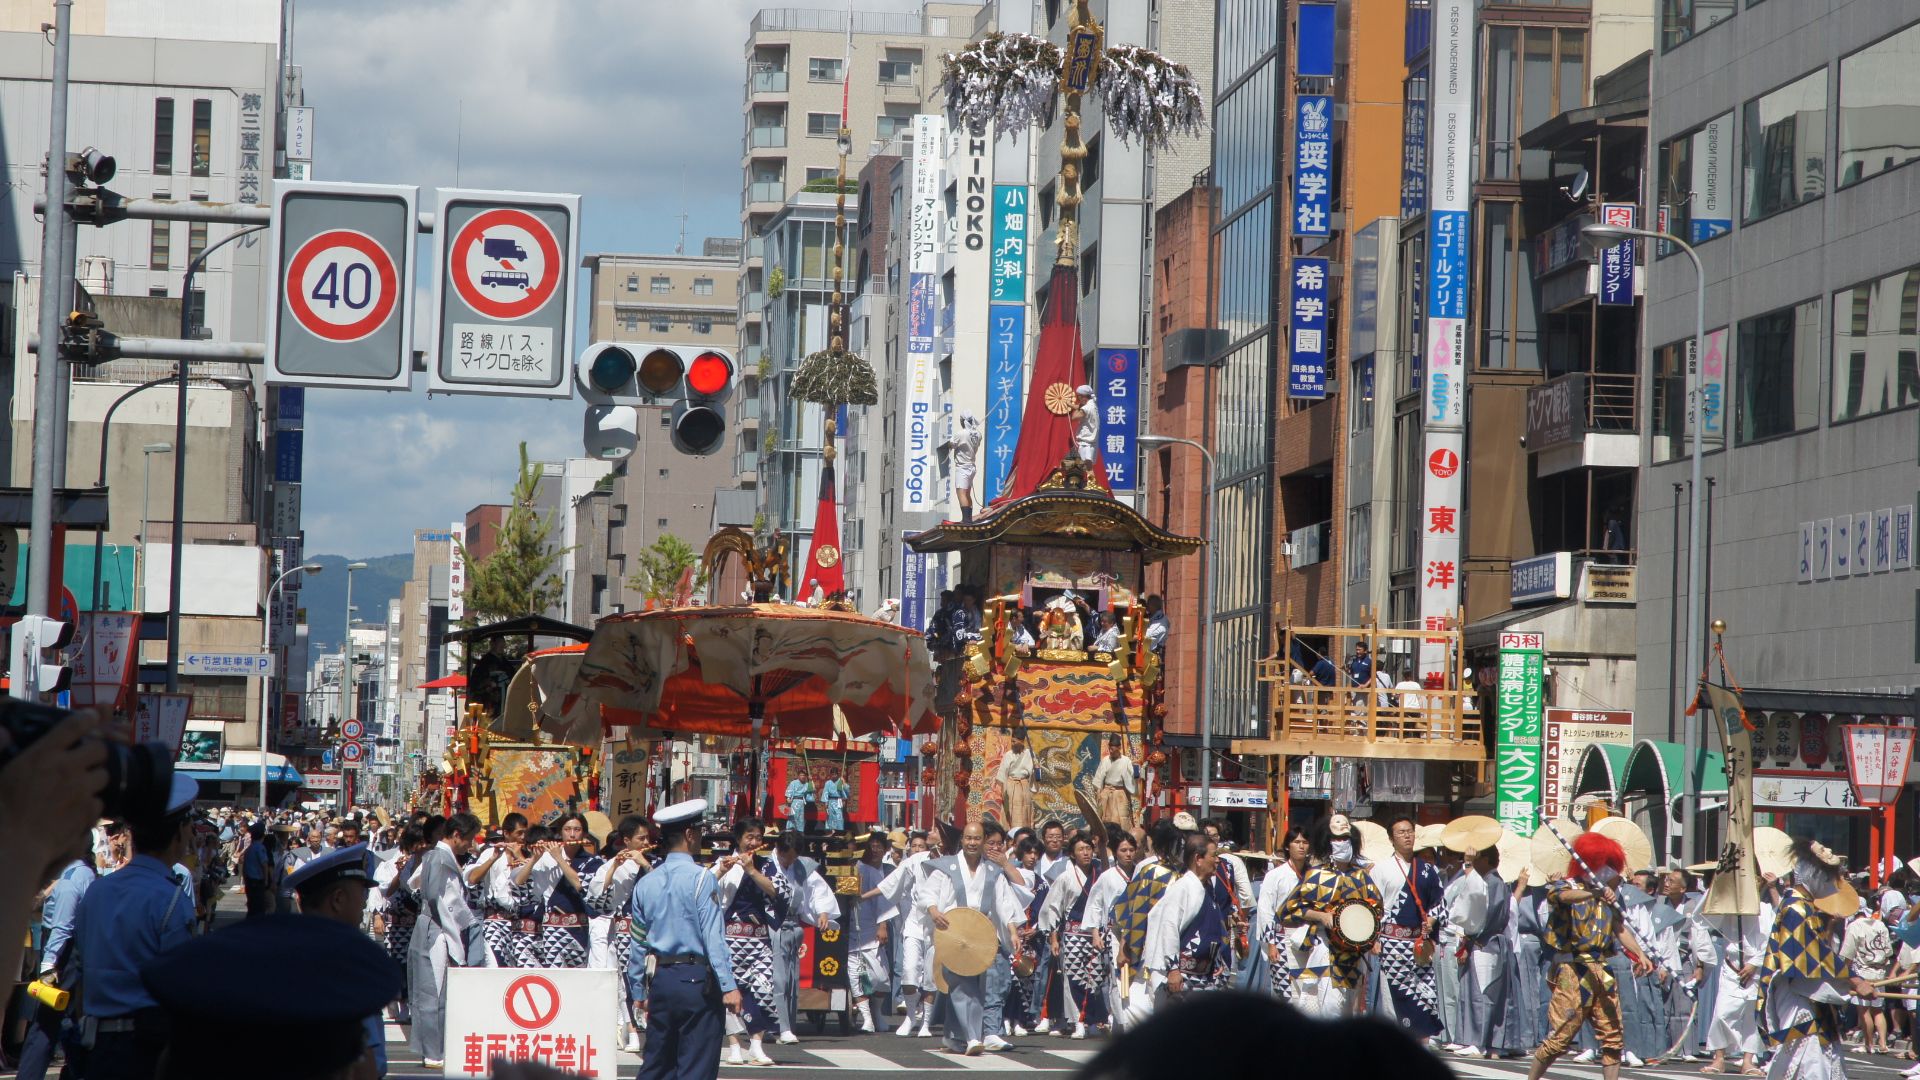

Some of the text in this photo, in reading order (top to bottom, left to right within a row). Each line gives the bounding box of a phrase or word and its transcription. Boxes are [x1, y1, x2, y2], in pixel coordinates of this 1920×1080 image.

[1449, 6, 1459, 95] DESIGN UNDERMINED
[1446, 113, 1456, 202] DESIGN UNDERMINED
[1297, 141, 1329, 232] 奨学社
[913, 204, 923, 269] ダンスシアター
[923, 198, 936, 253] マ・リ・コ
[1003, 188, 1024, 279] 小畑内科
[311, 261, 373, 310] 40
[994, 248, 1004, 296] クリニック
[1437, 232, 1455, 315] ゴールフリー
[1296, 265, 1325, 353] 希学園
[460, 352, 544, 372] マイクロを除く
[1300, 374, 1316, 383] 教室
[905, 402, 929, 503] Brain Yoga
[1105, 378, 1127, 482] 名鉄観光
[1800, 511, 1910, 575] ようこそ祇園
[201, 656, 253, 666] 市営駐車場
[259, 658, 268, 671] P
[1502, 634, 1540, 649] 内科
[1500, 653, 1525, 743] 糖尿病センター
[1526, 666, 1538, 734] 井上クリニック
[346, 724, 358, 734] 40
[1548, 746, 1557, 757] 4
[1550, 727, 1557, 737] 5
[1776, 715, 1792, 759] 函谷鉾
[1548, 765, 1556, 775] 3
[1887, 741, 1901, 781] 函谷鉾
[1500, 748, 1536, 838] 大クマ眼科
[1548, 784, 1556, 794] 2
[1549, 803, 1554, 813] 1
[463, 1032, 599, 1078] 車両通行禁止
